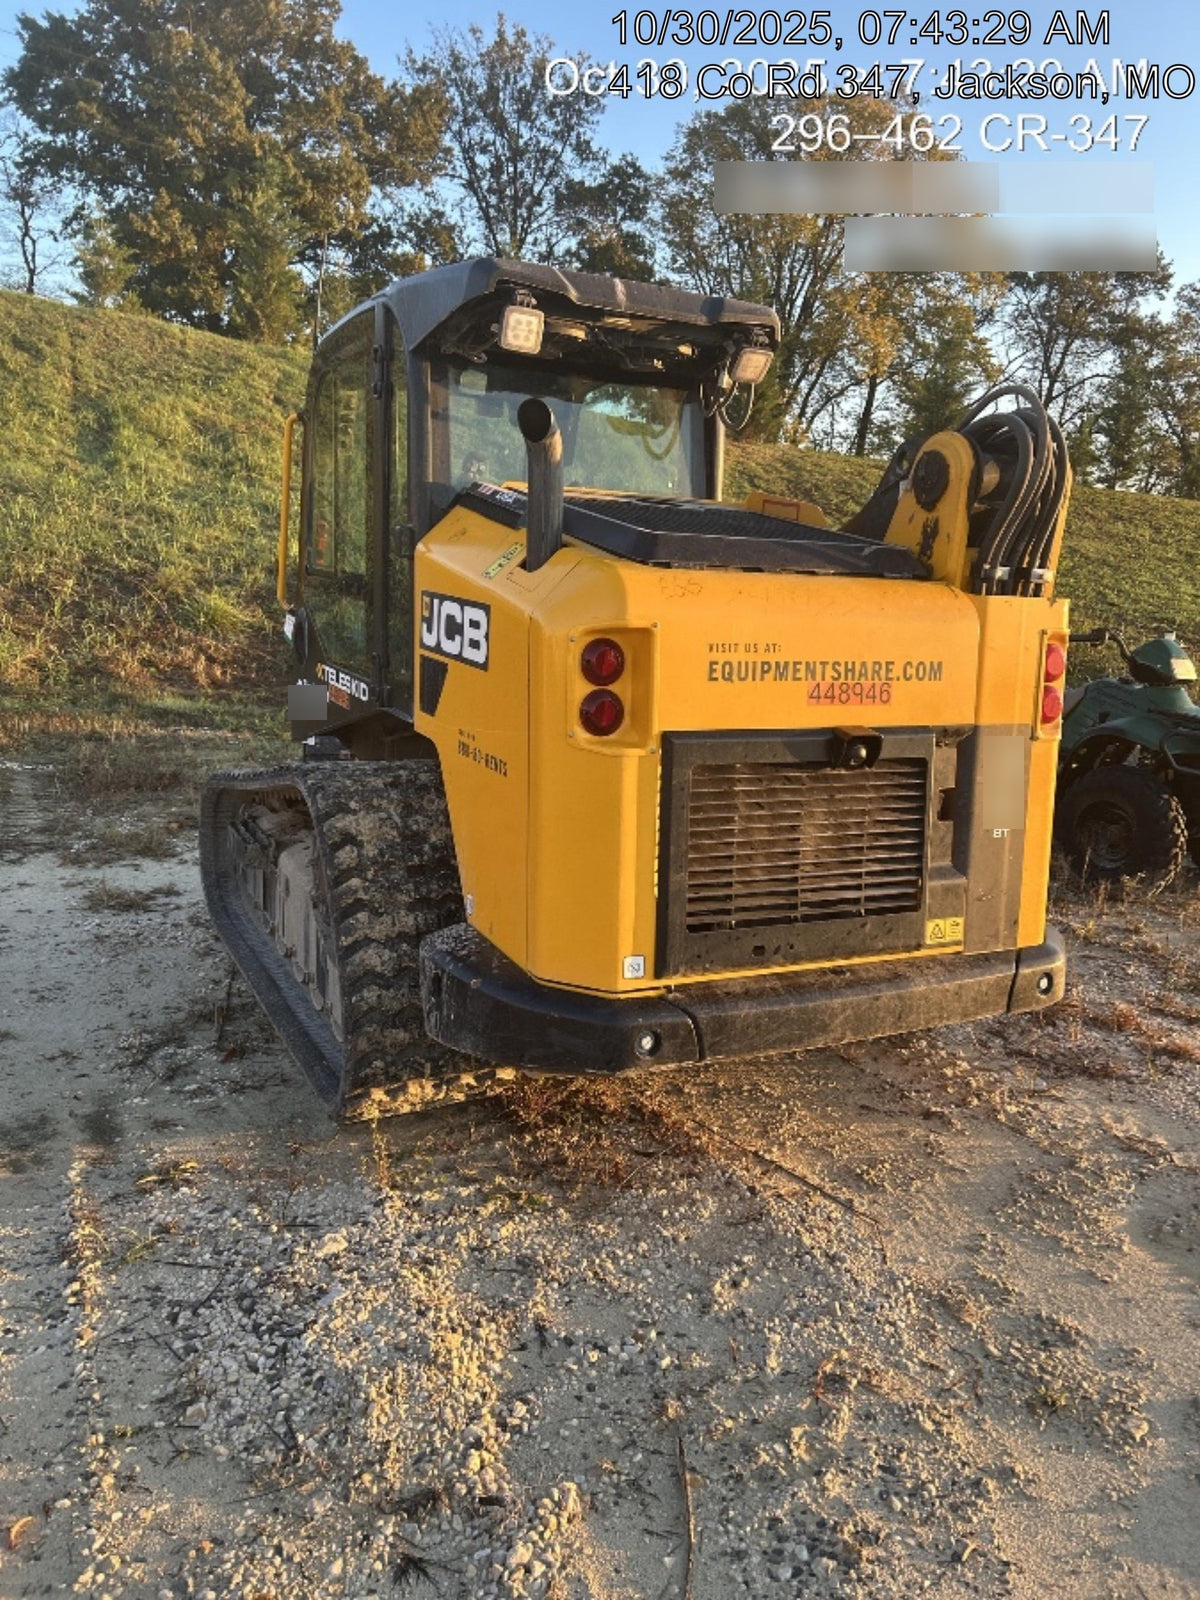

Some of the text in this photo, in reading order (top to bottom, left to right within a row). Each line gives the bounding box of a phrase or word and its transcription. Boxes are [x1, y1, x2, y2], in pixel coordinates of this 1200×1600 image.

[422, 598, 489, 664] JCB
[708, 643, 782, 653] VISIT US AT:
[707, 661, 944, 684] EQUIPMENTSHARE.COM
[808, 682, 892, 705] 448946
